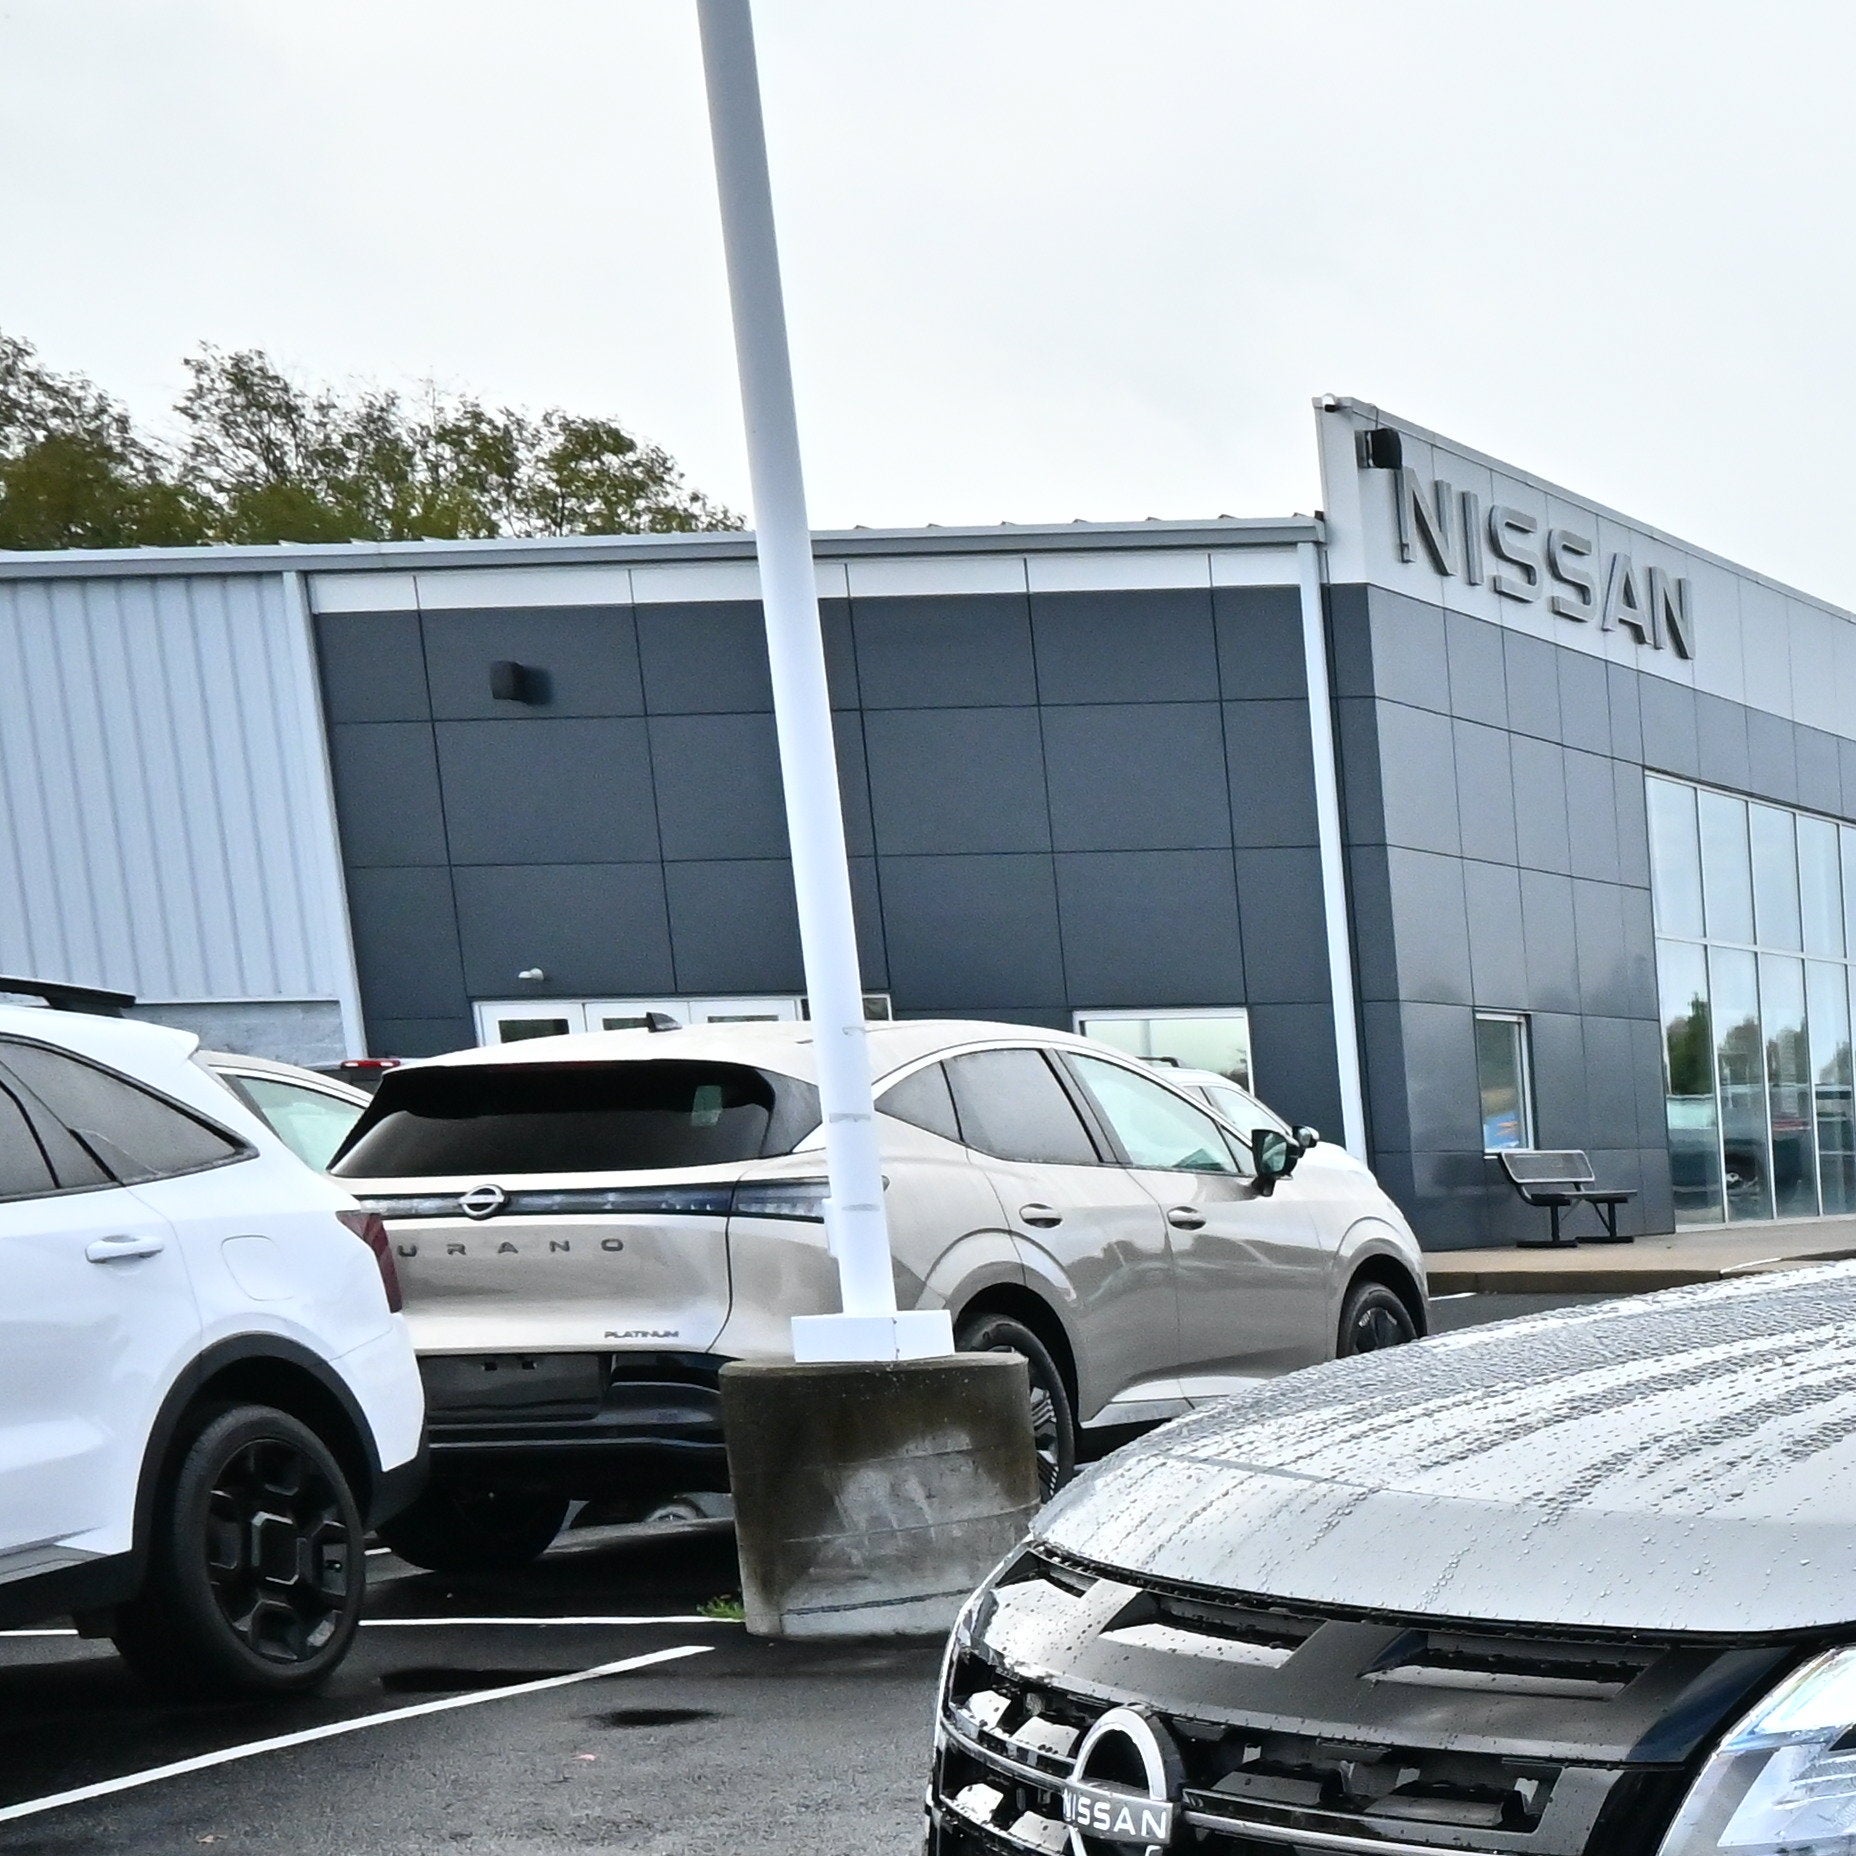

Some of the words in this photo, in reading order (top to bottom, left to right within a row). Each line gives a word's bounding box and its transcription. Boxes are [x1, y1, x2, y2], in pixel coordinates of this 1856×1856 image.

[1393, 464, 1697, 661] NISSAN
[604, 1330, 679, 1338] PLATINUM
[1062, 1787, 1168, 1839] NISSAN
